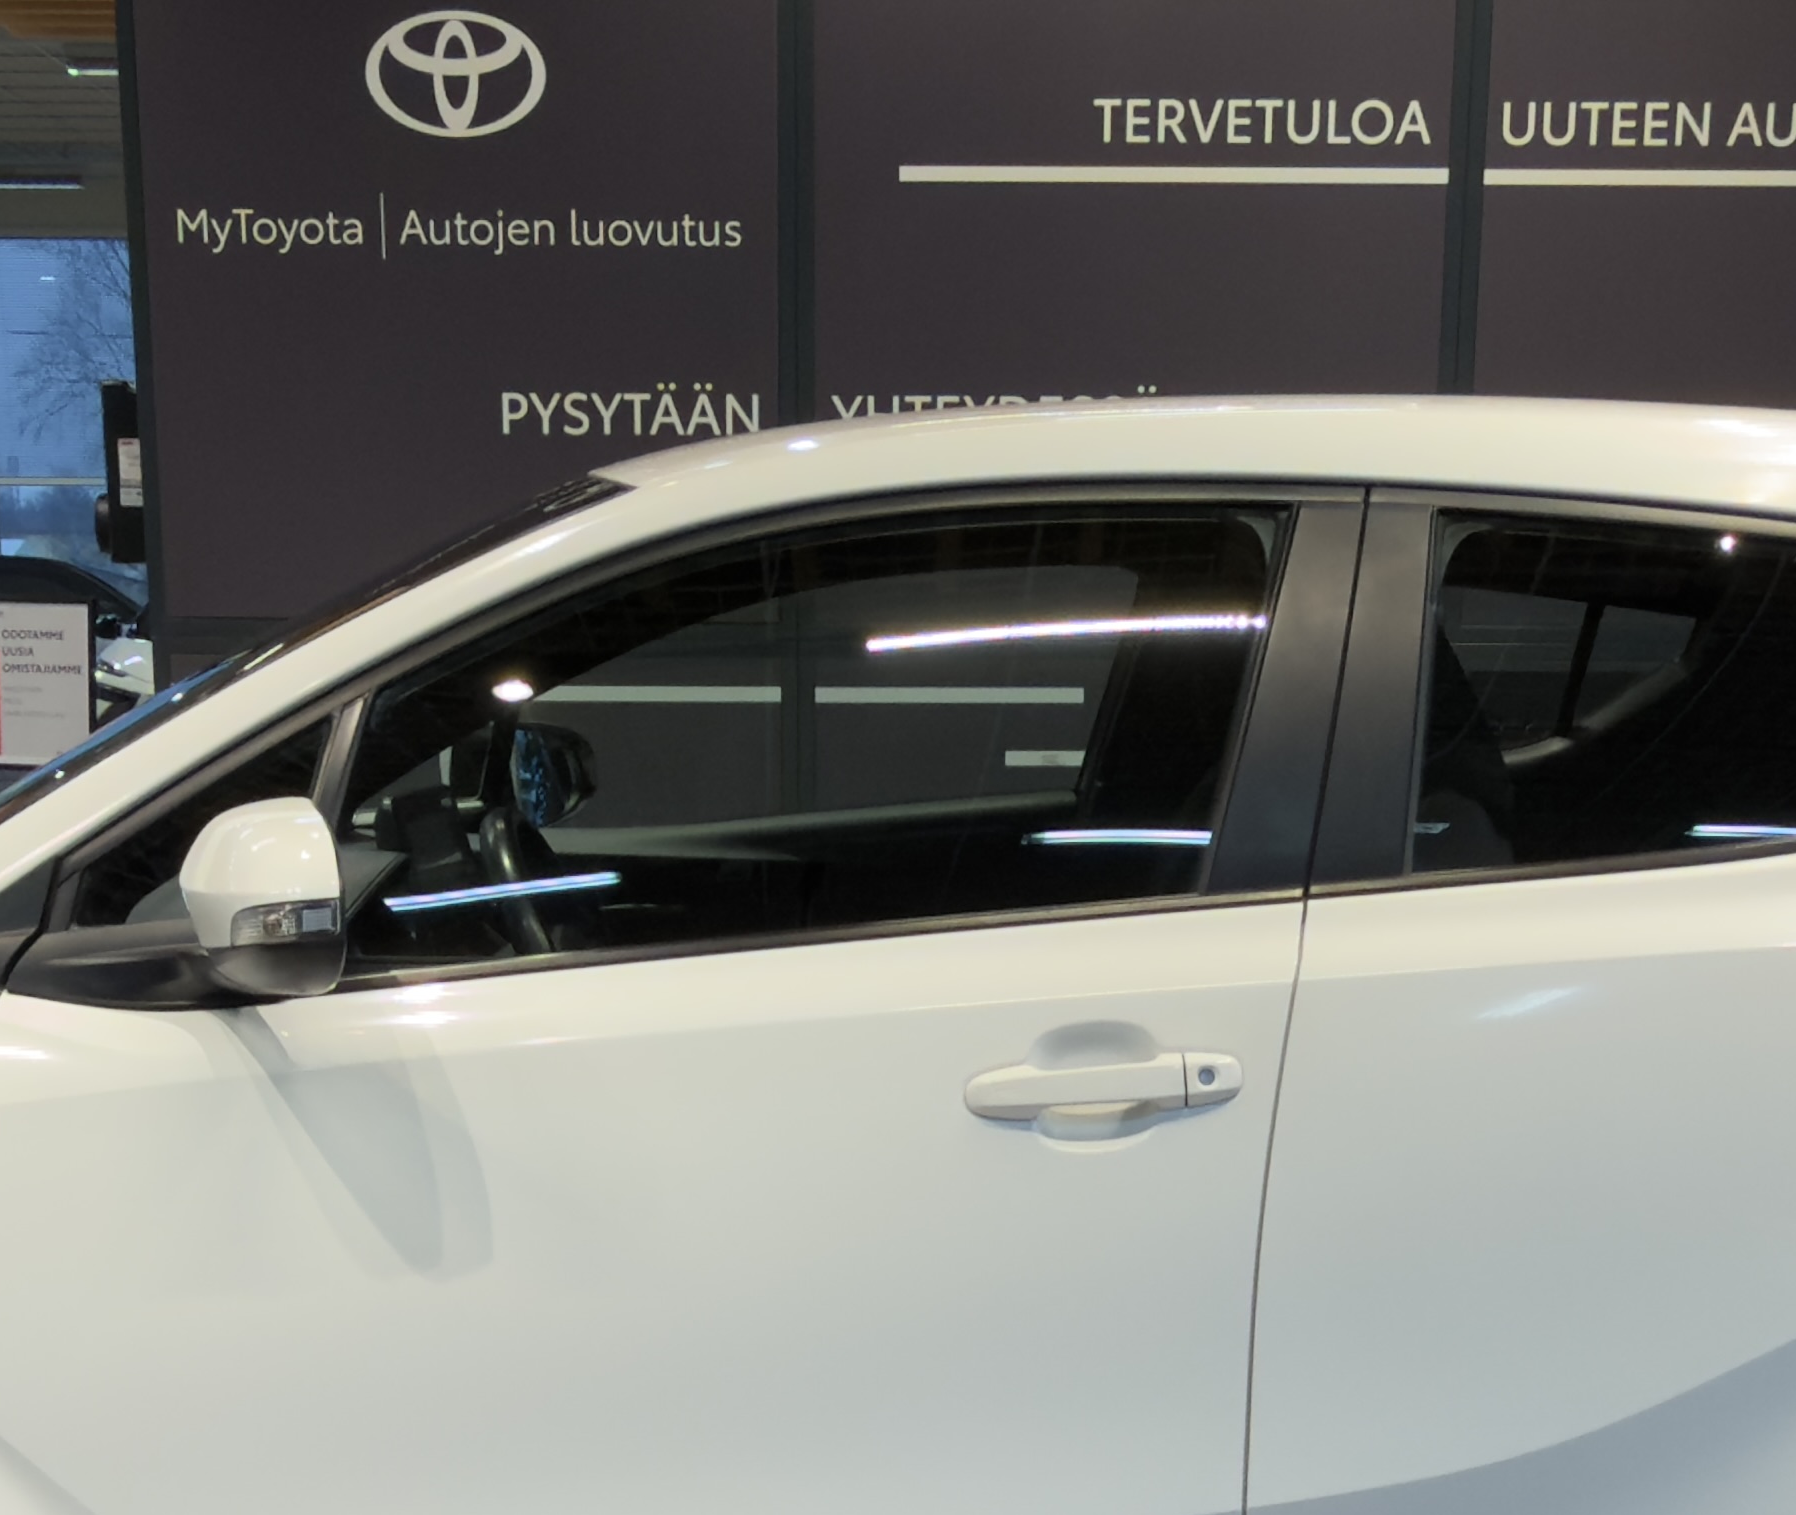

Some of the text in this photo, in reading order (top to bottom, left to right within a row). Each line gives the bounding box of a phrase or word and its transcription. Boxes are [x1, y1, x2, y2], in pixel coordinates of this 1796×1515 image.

[1093, 98, 1431, 145] TERVETULOA
[1502, 101, 1713, 148] UUTEEN
[176, 208, 742, 255] MyToyota Autojen luovutus
[502, 382, 759, 436] PYSYTÄÄN
